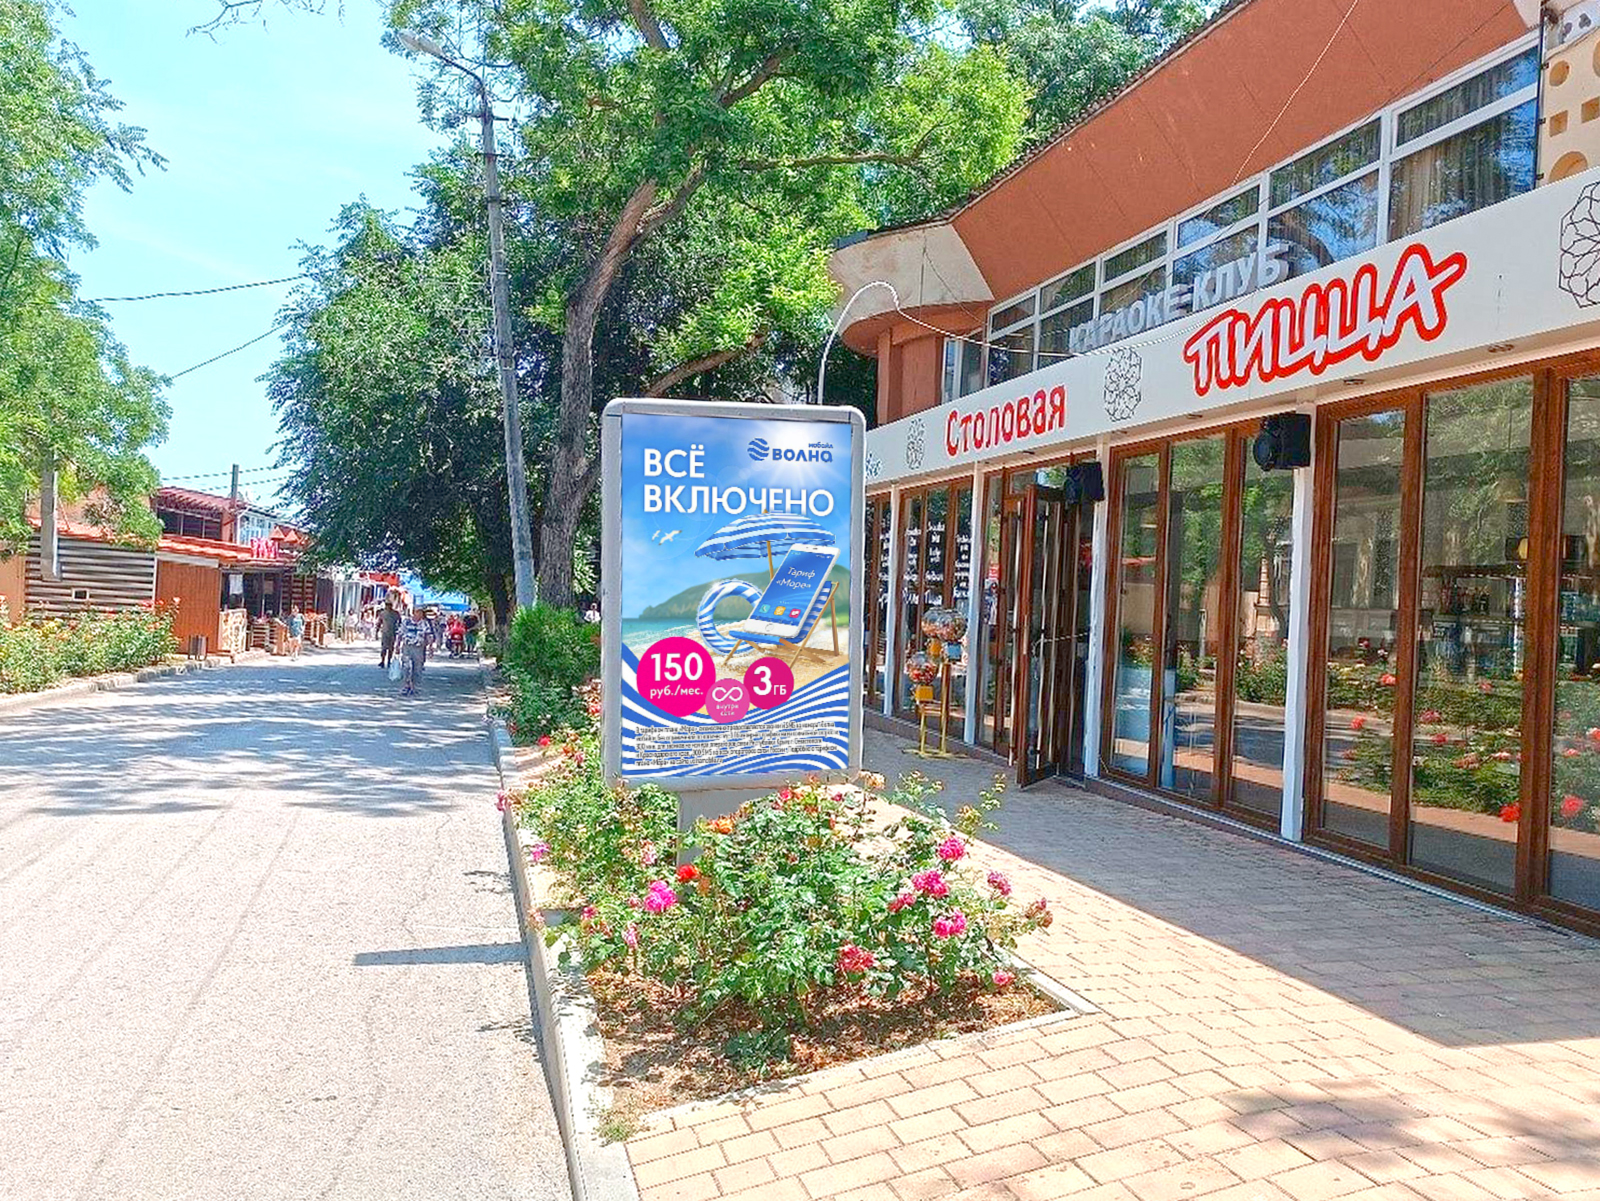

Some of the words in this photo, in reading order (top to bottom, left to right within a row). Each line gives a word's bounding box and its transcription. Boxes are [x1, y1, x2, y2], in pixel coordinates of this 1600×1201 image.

[1184, 242, 1468, 396] ПИЦЦА
[643, 443, 706, 479] ВСЁ
[643, 484, 835, 517] ВКЛЮЧЕНО
[776, 577, 812, 590] «Море»
[787, 566, 816, 580] Тариф
[650, 652, 704, 682] 150
[753, 665, 773, 697] 3
[773, 684, 787, 697] ГБ
[649, 683, 704, 700] руб./мес.
